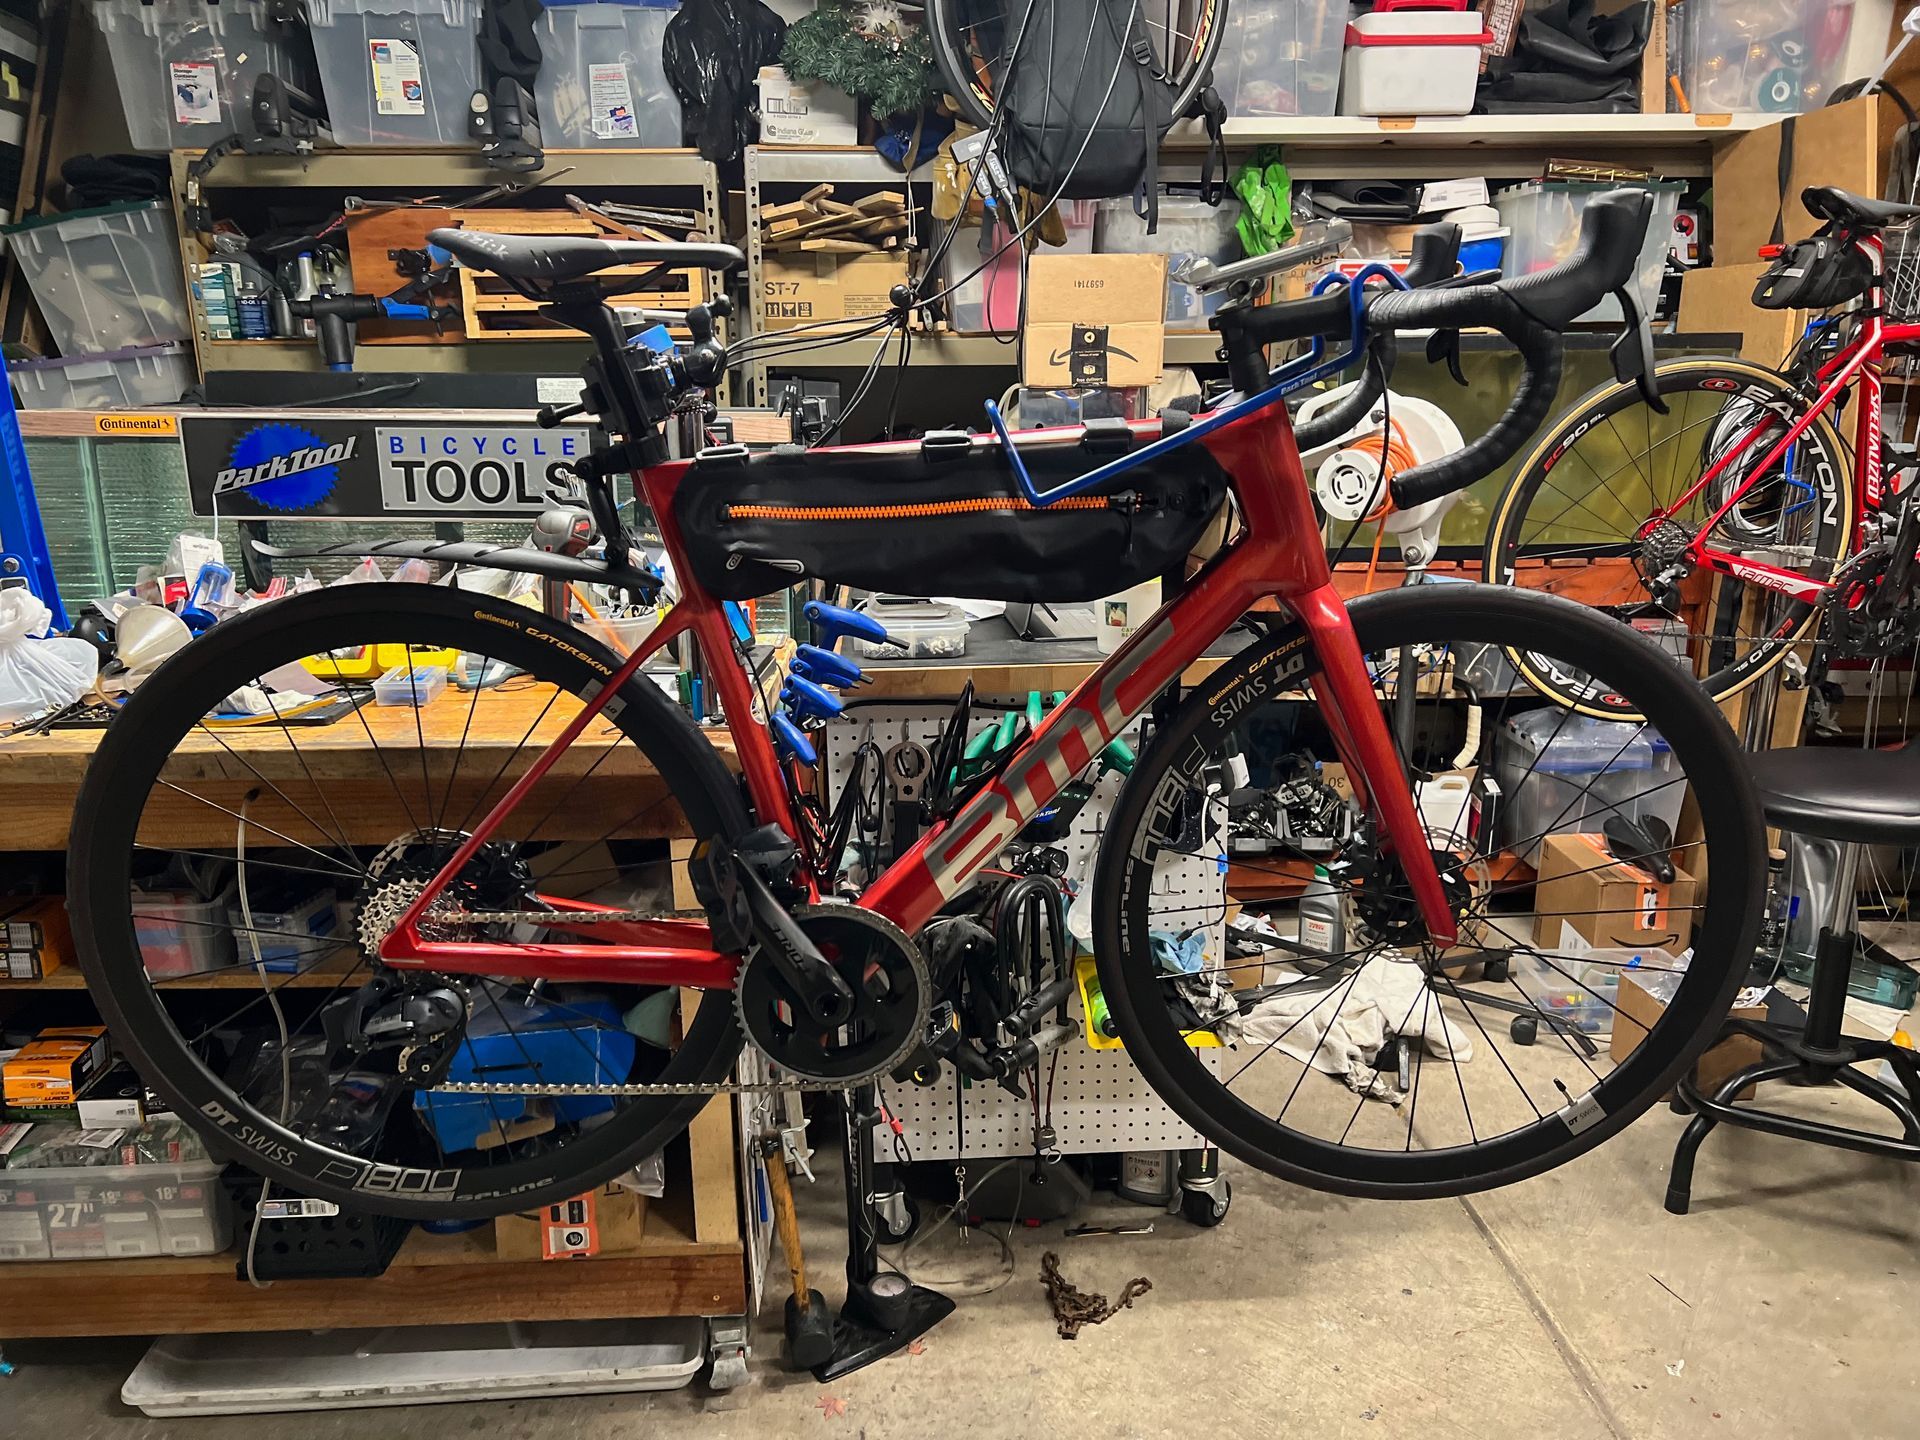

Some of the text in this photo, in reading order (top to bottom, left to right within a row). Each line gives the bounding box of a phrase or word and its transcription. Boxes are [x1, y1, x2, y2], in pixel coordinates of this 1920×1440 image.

[776, 127, 797, 135] Indiana
[764, 281, 801, 296] ST-7
[99, 417, 161, 432] Continental
[389, 436, 575, 456] BICYCLE
[1866, 386, 1882, 500] SPECIALIZED
[213, 435, 357, 495] ParkTool
[390, 459, 582, 504] TOOLS
[473, 610, 613, 677] Continental GATORSKIN
[1207, 634, 1308, 706] Continental GATORS
[1210, 652, 1305, 728] DT SWISS
[923, 617, 1176, 901] BMC
[1328, 776, 1345, 788] 30
[1035, 806, 1062, 819] rkTool
[1568, 1103, 1599, 1126] DT SWISS
[199, 1100, 298, 1167] DT SWISS
[47, 1202, 95, 1228] 27"
